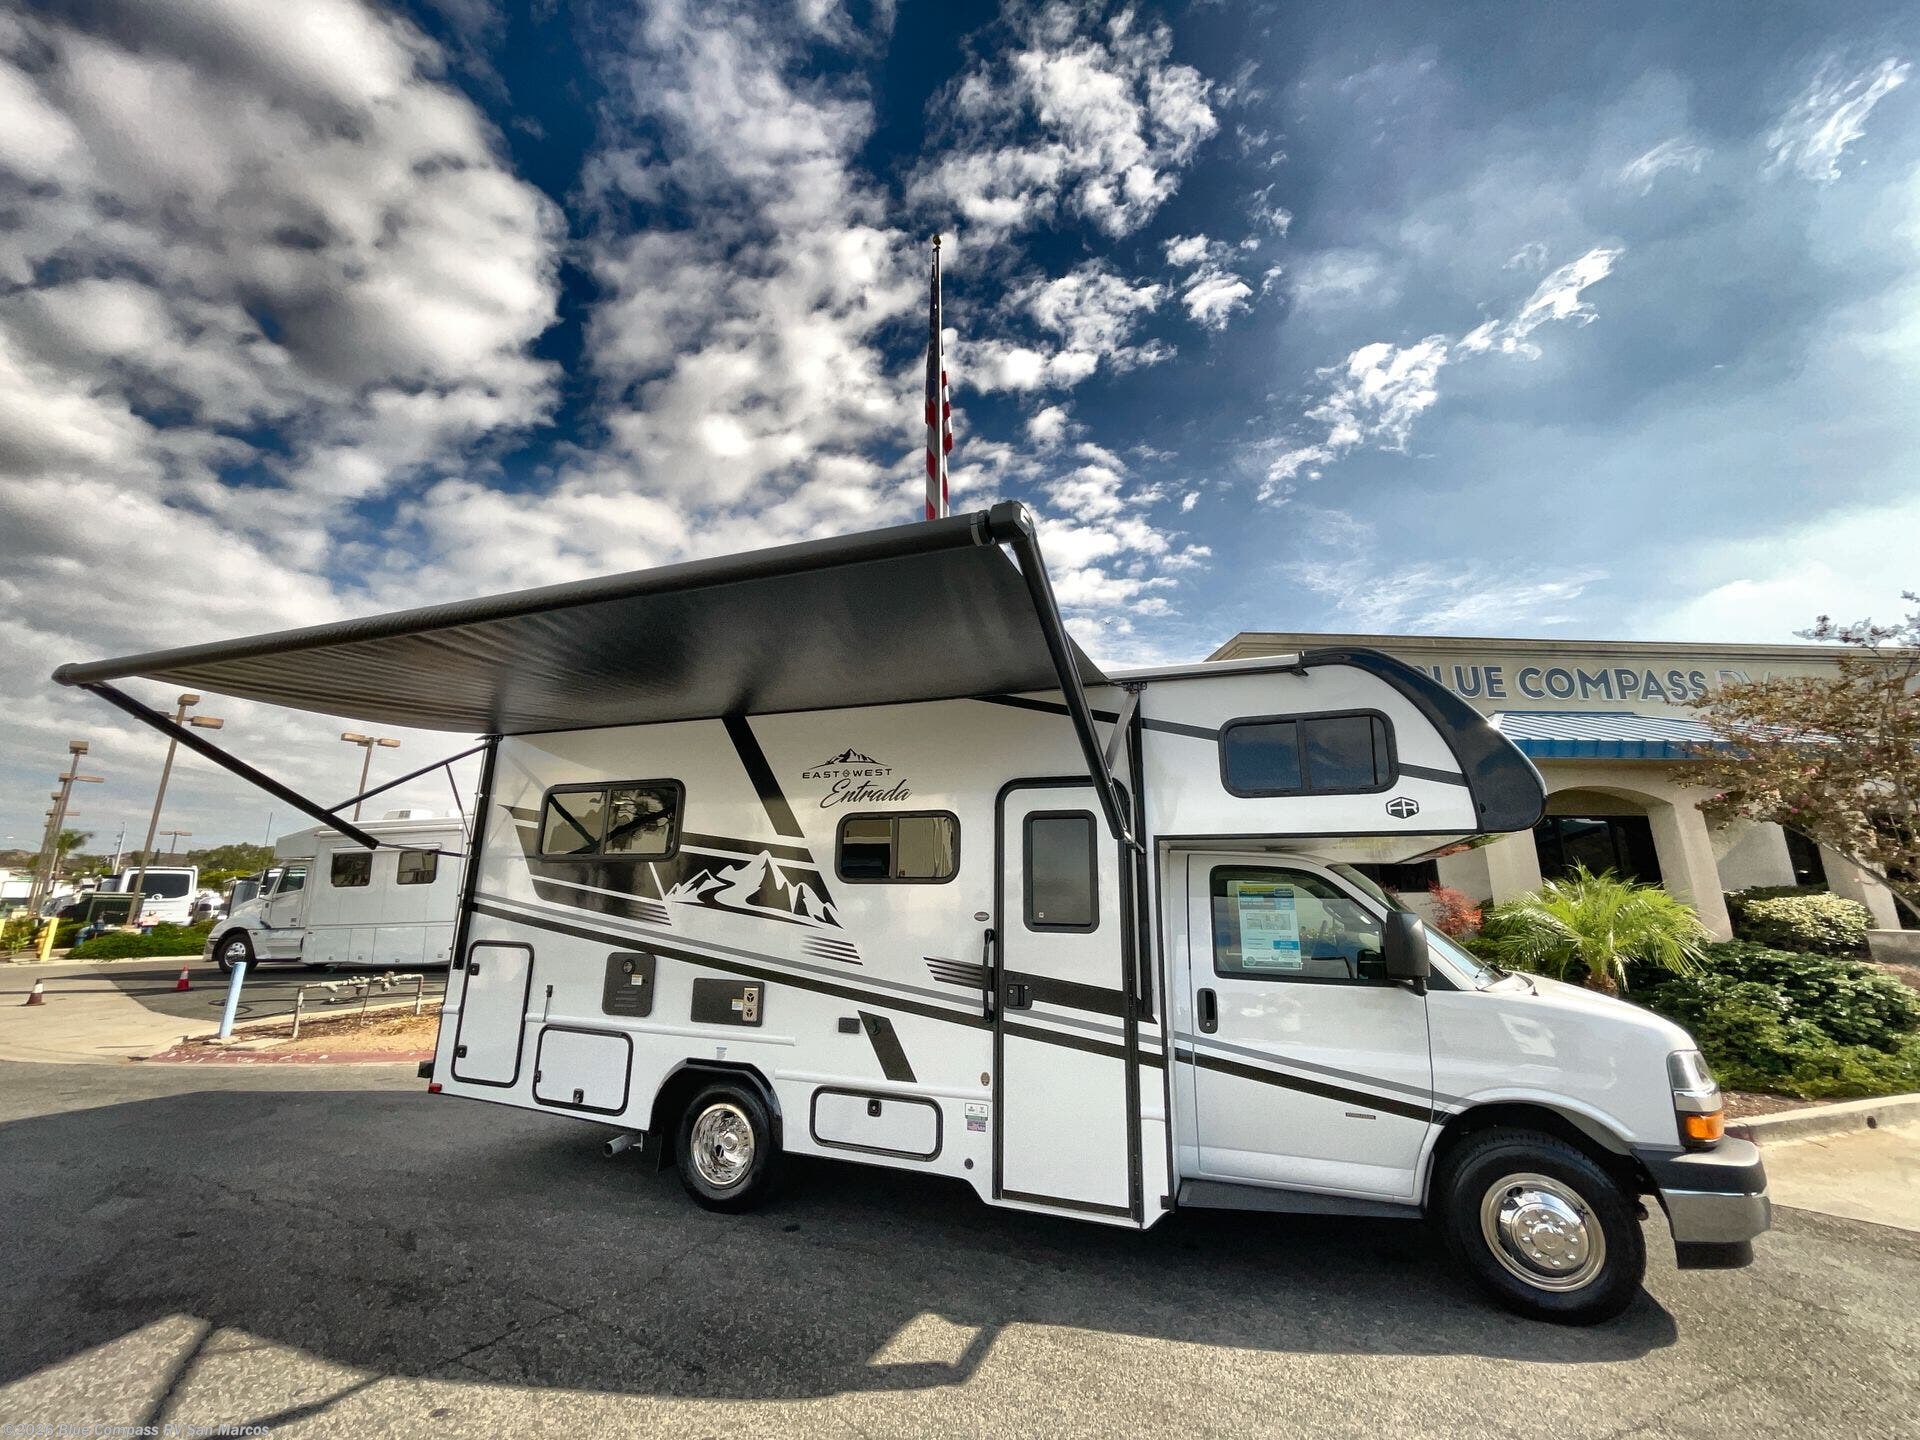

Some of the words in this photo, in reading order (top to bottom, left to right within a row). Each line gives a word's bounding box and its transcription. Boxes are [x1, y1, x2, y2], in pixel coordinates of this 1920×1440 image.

[1517, 667, 1709, 700] COMPASS
[802, 770, 840, 779] EAST
[852, 768, 893, 777] WEST
[820, 778, 912, 809] Entrada
